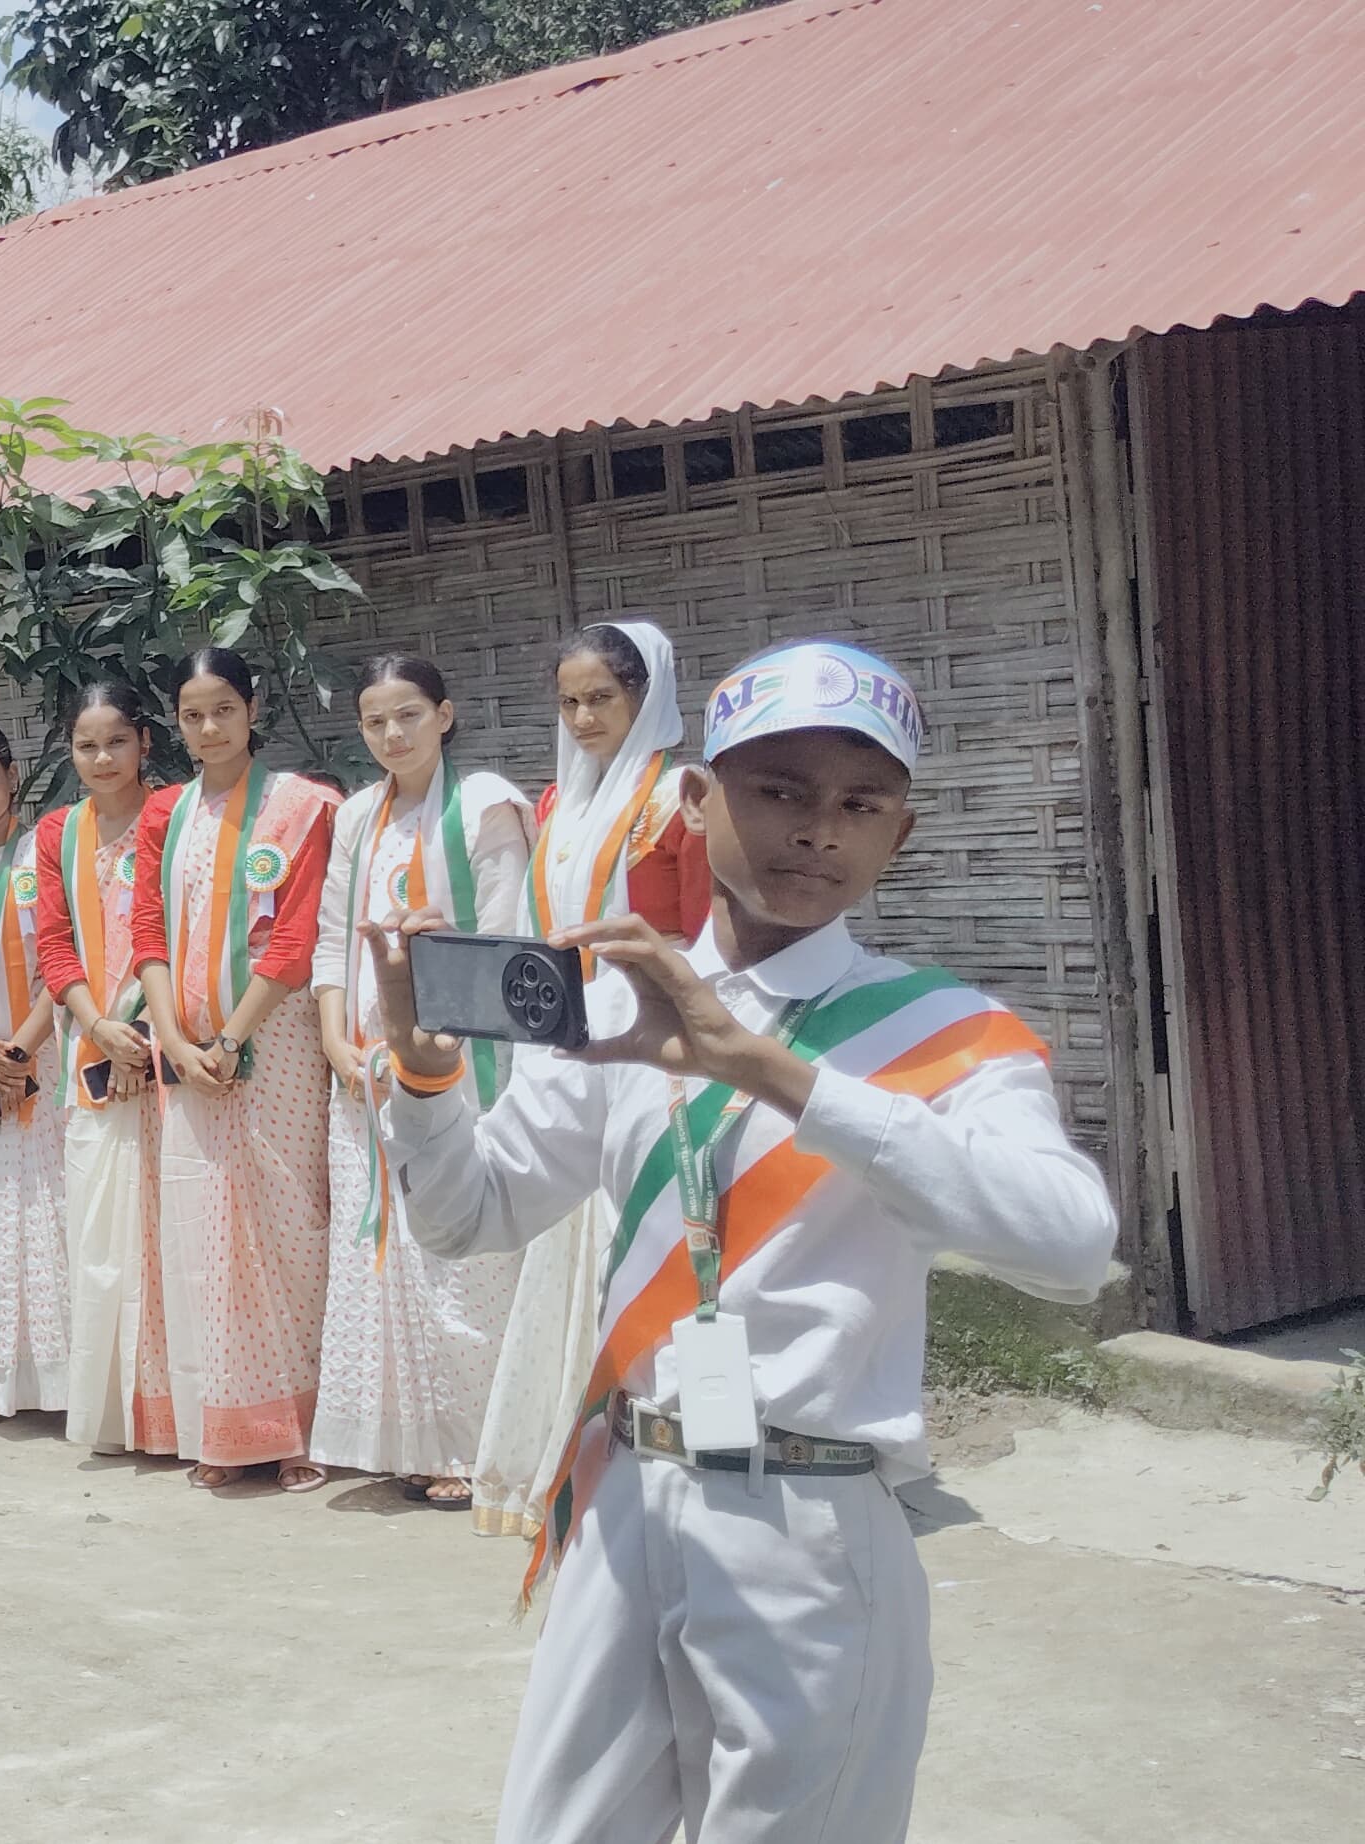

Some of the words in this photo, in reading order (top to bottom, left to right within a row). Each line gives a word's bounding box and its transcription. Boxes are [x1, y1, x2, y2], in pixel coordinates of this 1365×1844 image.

[706, 675, 758, 735] AI
[675, 1107, 686, 1143] SCHOOL
[680, 1144, 694, 1186] ORIENTAL
[687, 1187, 699, 1217] ANGLO
[704, 1190, 715, 1221] ANGLO
